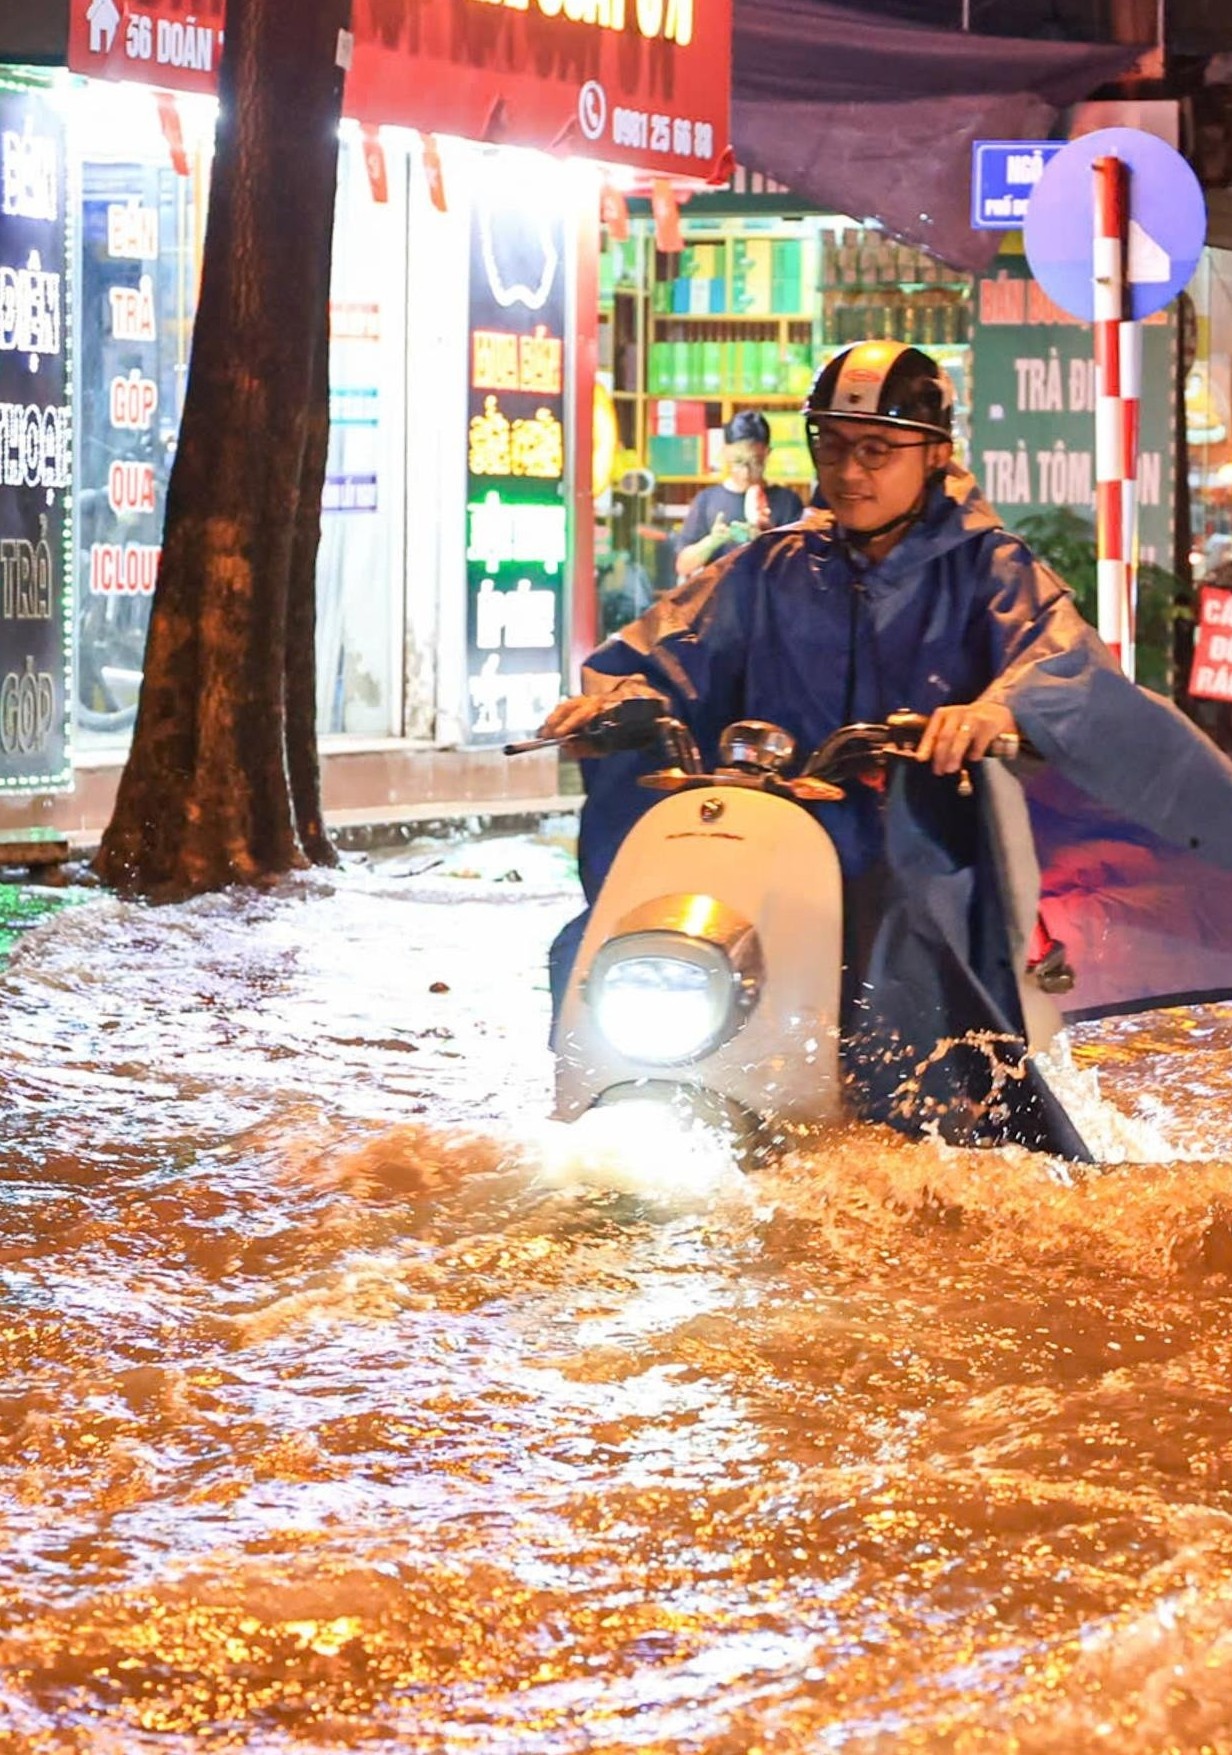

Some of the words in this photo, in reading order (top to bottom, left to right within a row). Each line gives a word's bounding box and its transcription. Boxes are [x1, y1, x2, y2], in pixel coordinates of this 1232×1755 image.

[157, 15, 213, 72] DOÃN
[111, 369, 157, 429] GÓP
[1015, 347, 1063, 411] TRÀ
[108, 461, 155, 513] QUA
[983, 440, 1031, 504] TRÀ
[0, 513, 53, 619] TRẢ
